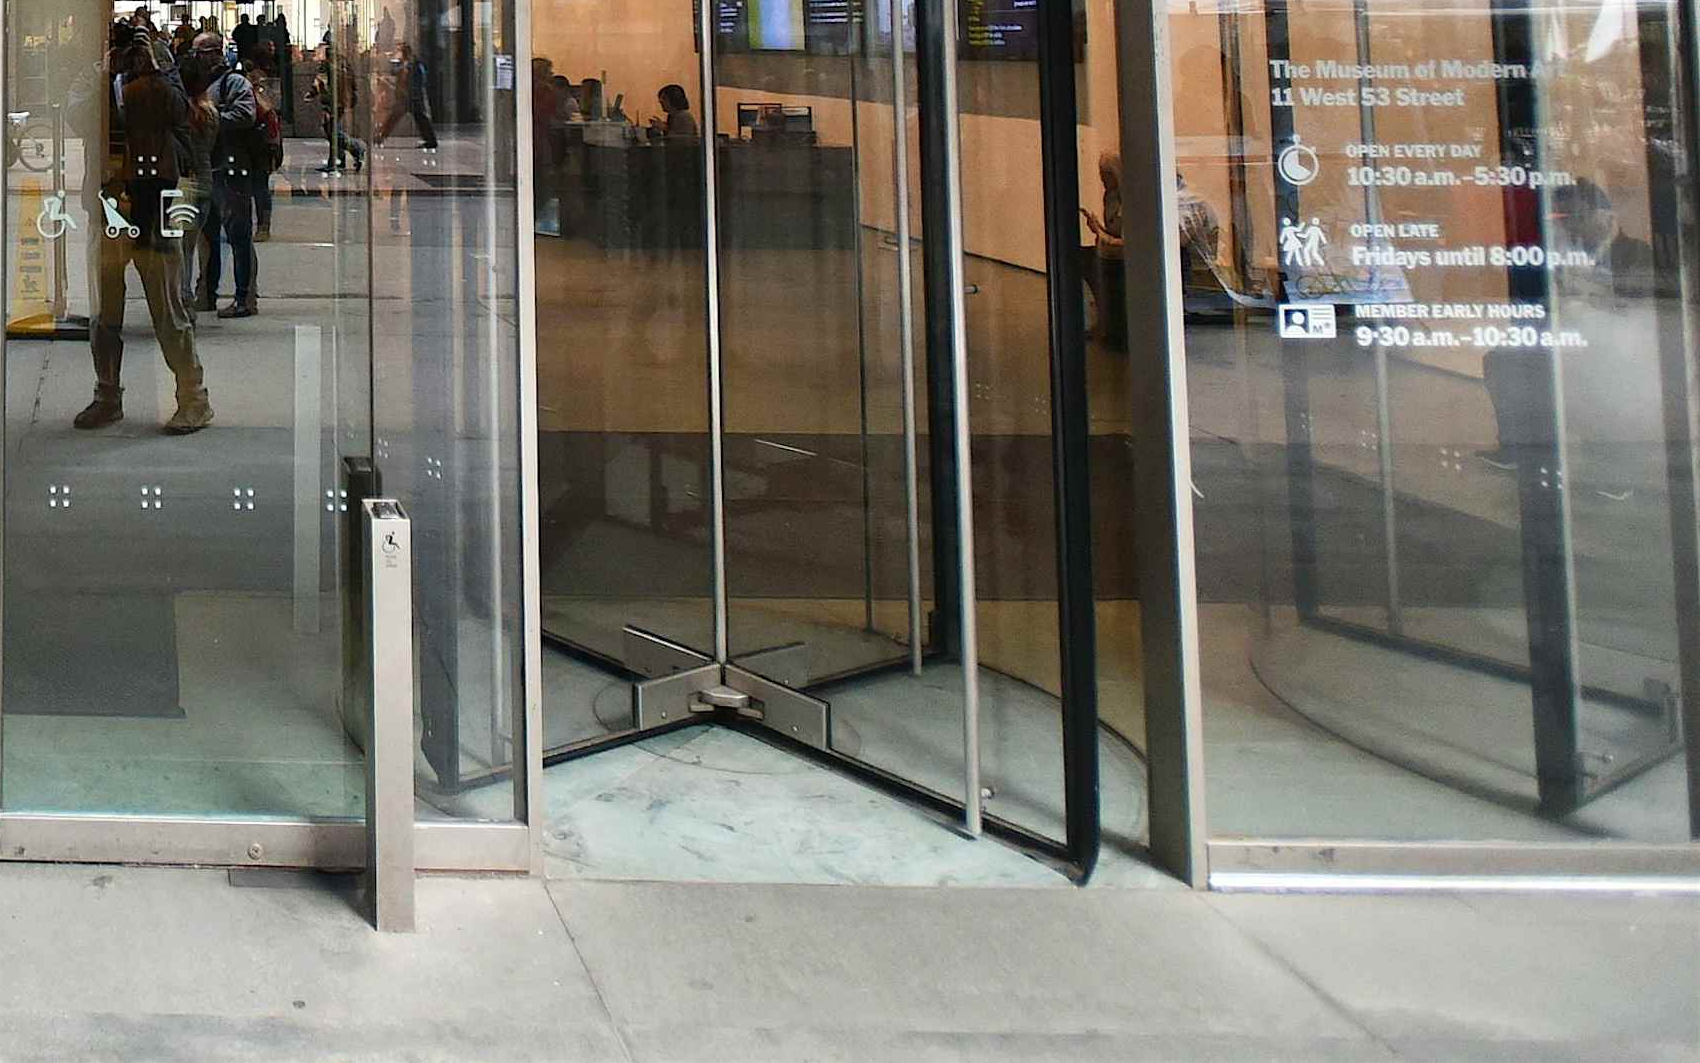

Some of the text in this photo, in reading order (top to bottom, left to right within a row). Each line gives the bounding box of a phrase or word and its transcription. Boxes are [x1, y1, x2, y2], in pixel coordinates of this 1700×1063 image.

[1270, 60, 1310, 79] The
[1315, 60, 1409, 79] Museum
[1415, 60, 1436, 79] of
[1443, 60, 1527, 79] Modern
[1272, 88, 1465, 106] 11 West 53 Street
[1346, 144, 1481, 158] OPEN EVERY DAY
[1348, 167, 1412, 186] 10:30
[1528, 171, 1576, 189] p.m.
[1351, 224, 1439, 237] OPEN LATE
[1352, 246, 1595, 270] Fridays until 8:00 p.m.
[1356, 304, 1545, 318] MEMBER EARLY HOURS
[1541, 330, 1588, 347] a.m.
